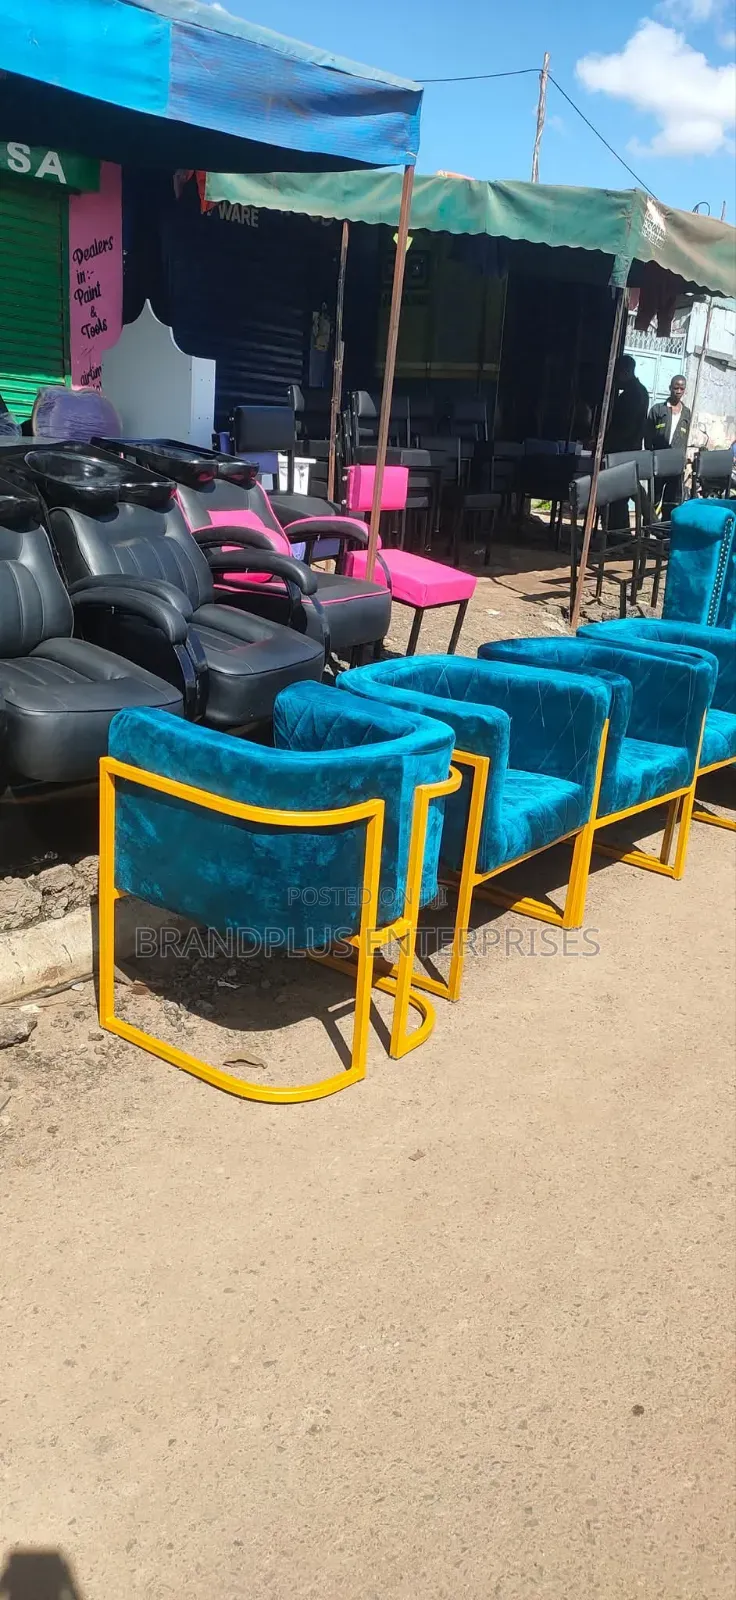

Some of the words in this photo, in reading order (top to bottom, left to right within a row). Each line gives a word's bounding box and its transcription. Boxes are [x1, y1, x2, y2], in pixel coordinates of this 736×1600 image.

[7, 142, 67, 184] SA
[219, 200, 259, 228] WARE
[72, 236, 114, 266] Dealers
[74, 281, 102, 306] Paint
[90, 305, 98, 318] &
[81, 318, 108, 340] Tools
